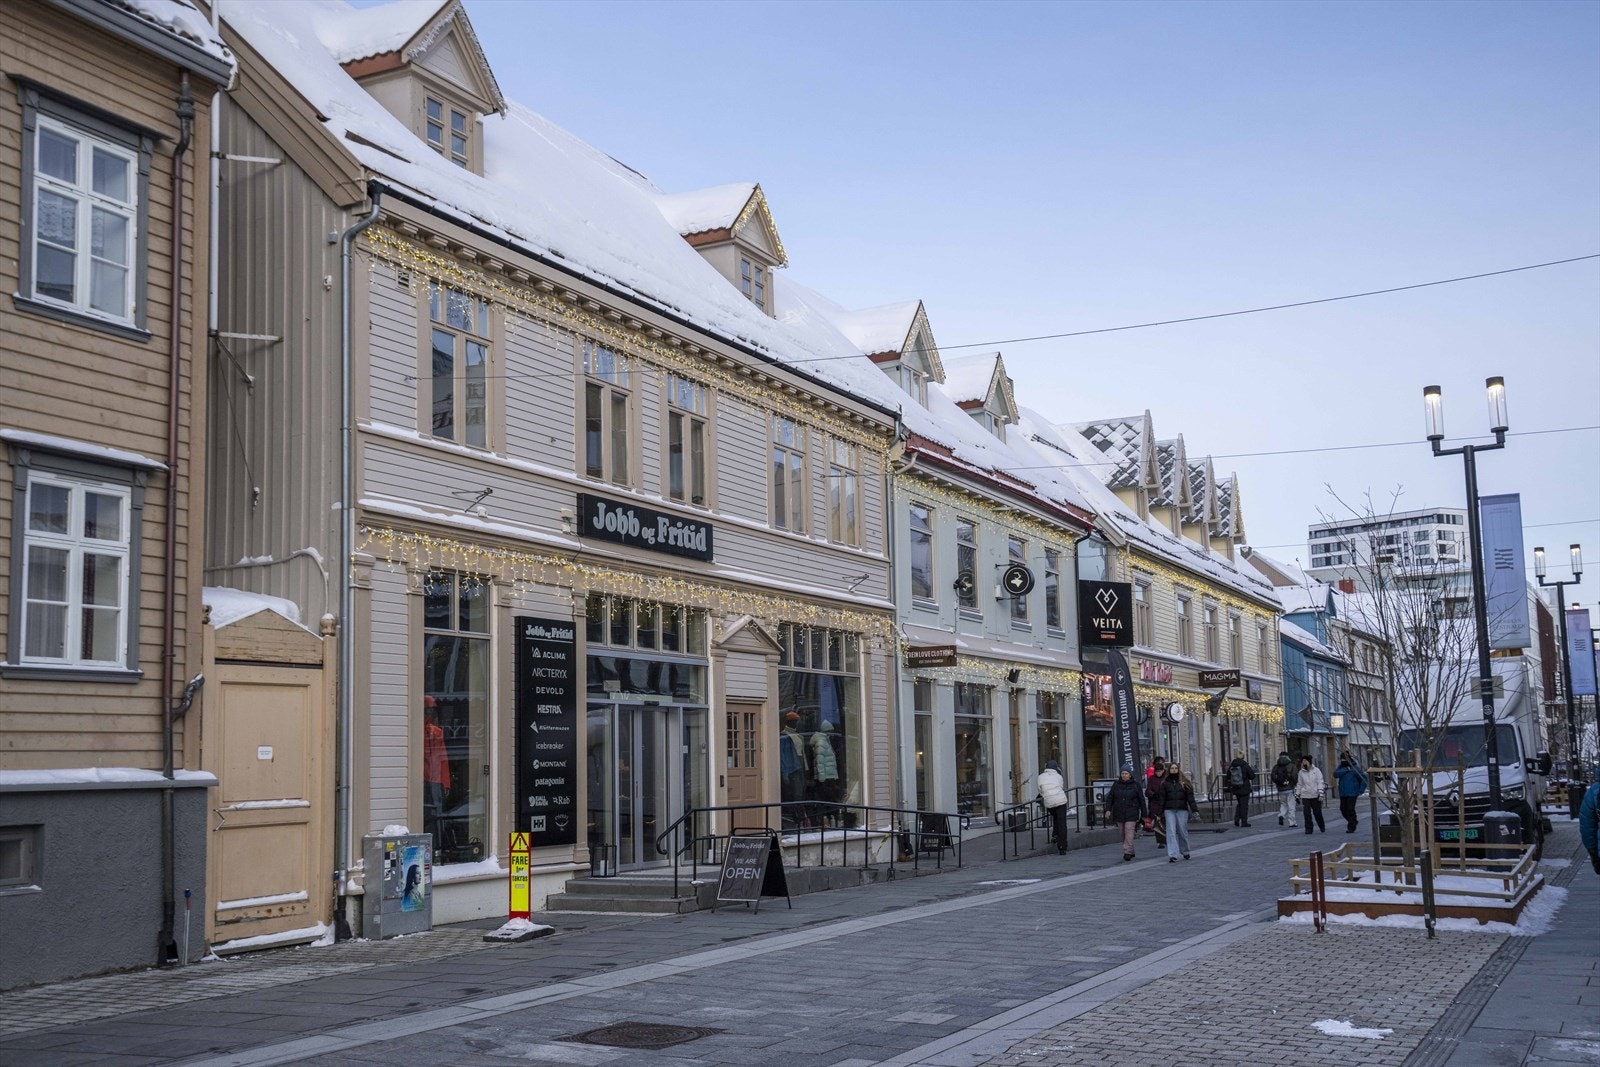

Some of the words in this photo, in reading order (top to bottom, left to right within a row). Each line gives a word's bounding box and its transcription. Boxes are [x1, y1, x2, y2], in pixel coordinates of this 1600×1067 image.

[593, 502, 640, 538] Jobb
[641, 526, 655, 545] og
[657, 516, 707, 552] Fritid
[1092, 617, 1123, 629] VEITA
[525, 624, 545, 637] Jobb
[545, 631, 552, 639] og
[551, 627, 574, 640] Fritid
[542, 651, 566, 660] ACLIMA
[1204, 672, 1238, 681] MAGMA
[536, 686, 564, 695] DEVOLD
[537, 704, 562, 714] HESTRA
[535, 741, 564, 750] icebreaker
[535, 777, 565, 787] patagonia
[558, 795, 571, 805] Rab
[533, 818, 544, 829] HH
[511, 855, 528, 865] FARE
[725, 867, 761, 879] OPEN
